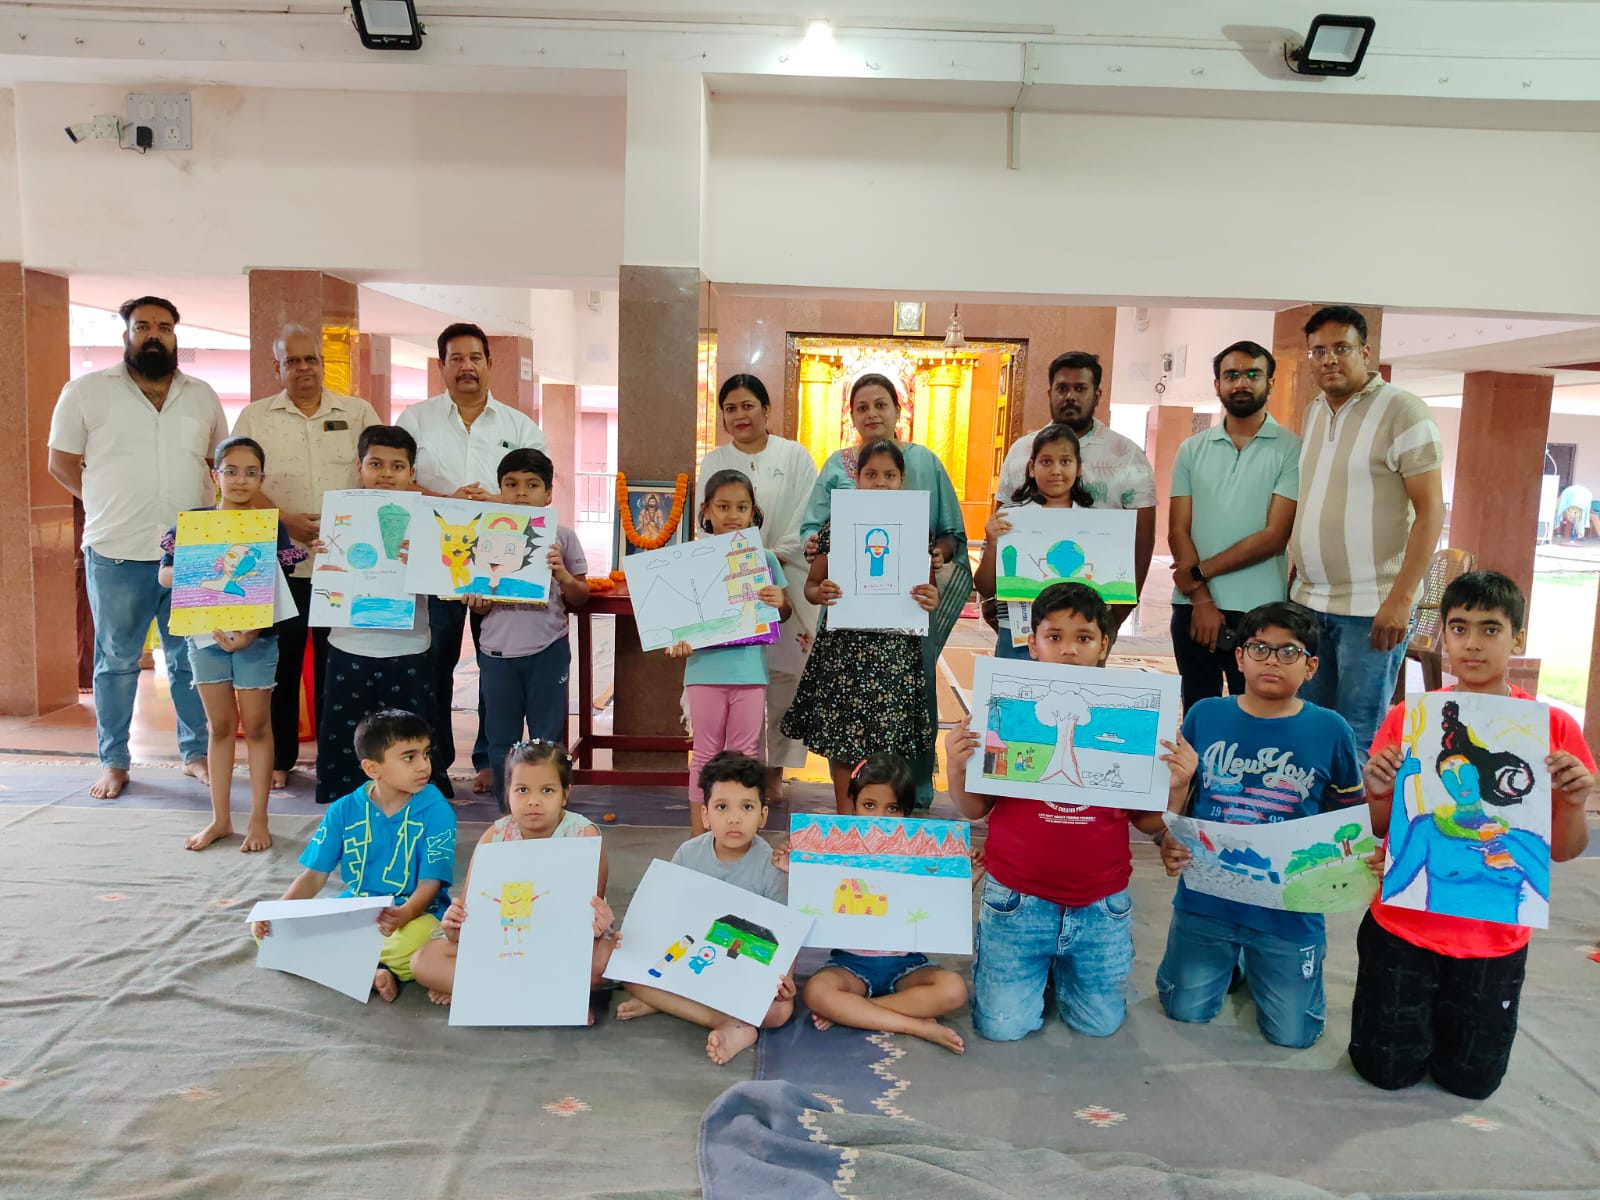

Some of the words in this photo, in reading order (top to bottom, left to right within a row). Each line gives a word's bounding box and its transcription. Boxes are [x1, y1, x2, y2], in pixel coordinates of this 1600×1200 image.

[1202, 740, 1268, 789] New
[1257, 748, 1316, 801] York
[1209, 805, 1222, 817] 19
